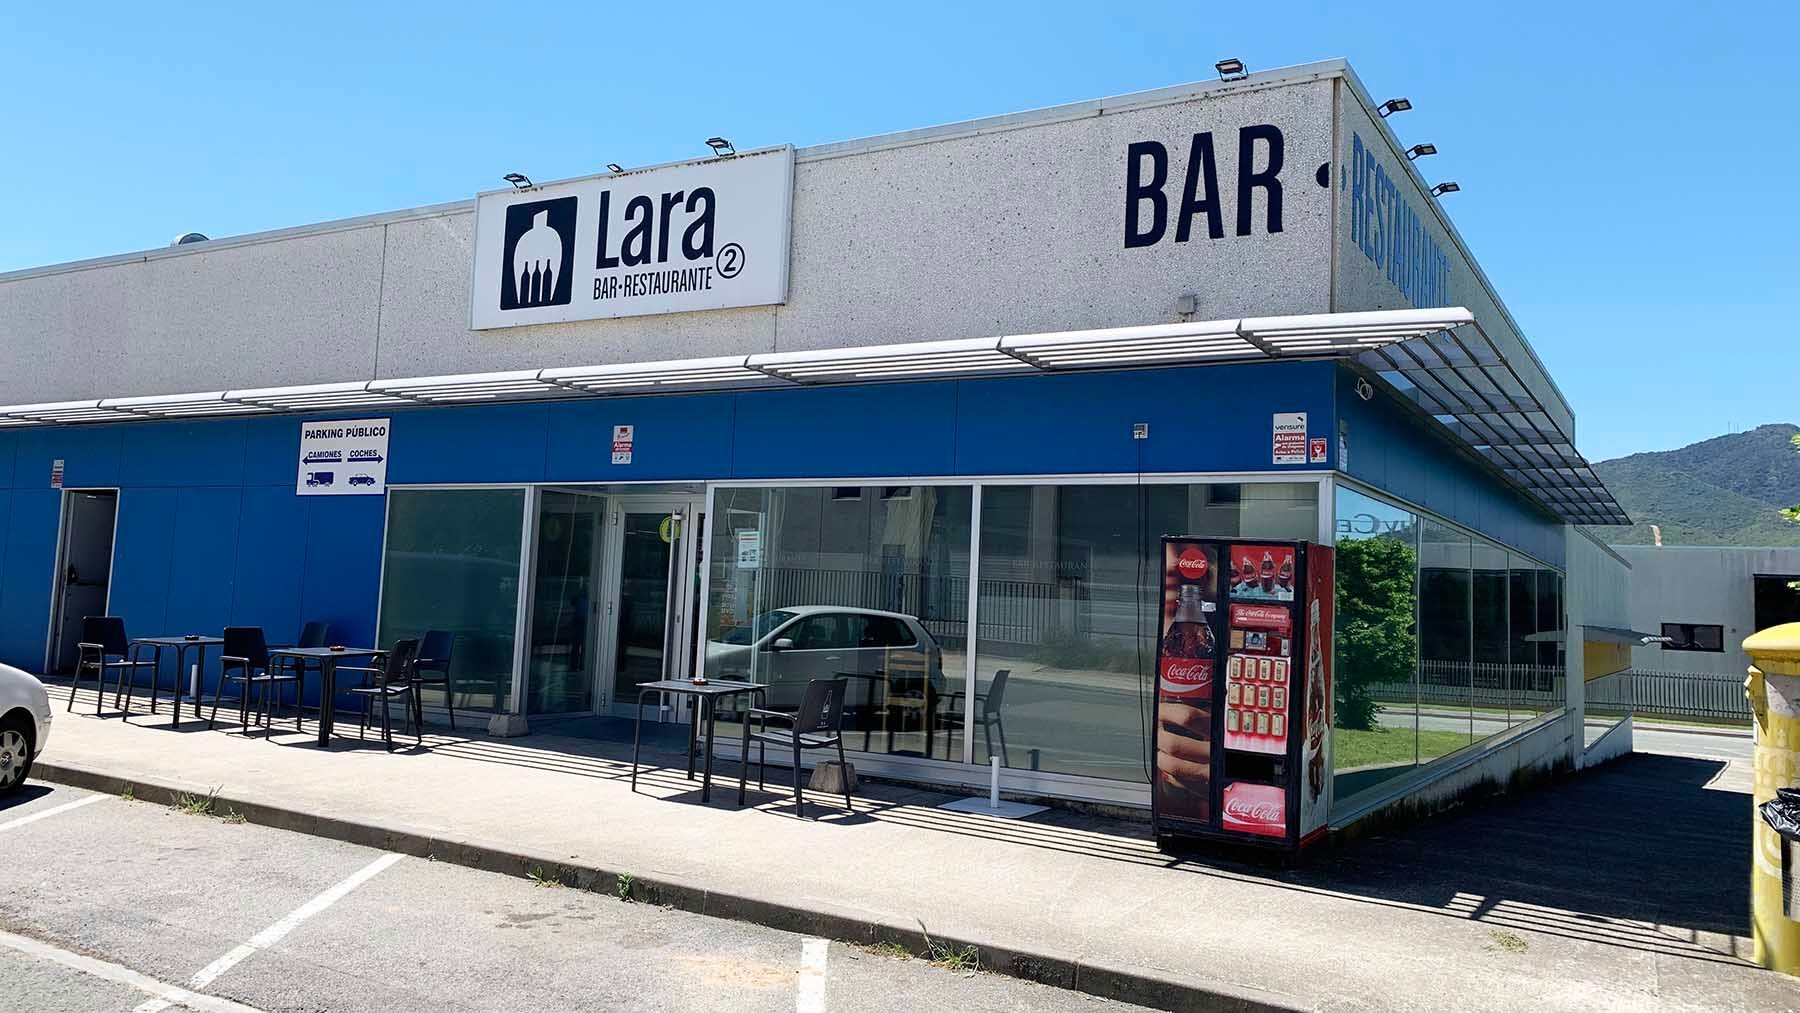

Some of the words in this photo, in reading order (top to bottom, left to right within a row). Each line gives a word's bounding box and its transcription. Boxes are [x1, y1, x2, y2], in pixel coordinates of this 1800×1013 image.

[1124, 124, 1285, 248] BAR
[596, 186, 716, 269] Lara
[304, 428, 344, 439] PARKING
[345, 424, 386, 437] PÚBLICO
[1275, 434, 1305, 442] Alarma
[308, 450, 342, 458] CAMIONES
[349, 449, 378, 457] COCHES
[1167, 663, 1210, 681] Coca-Cola
[1225, 798, 1281, 823] Coca-Cola
